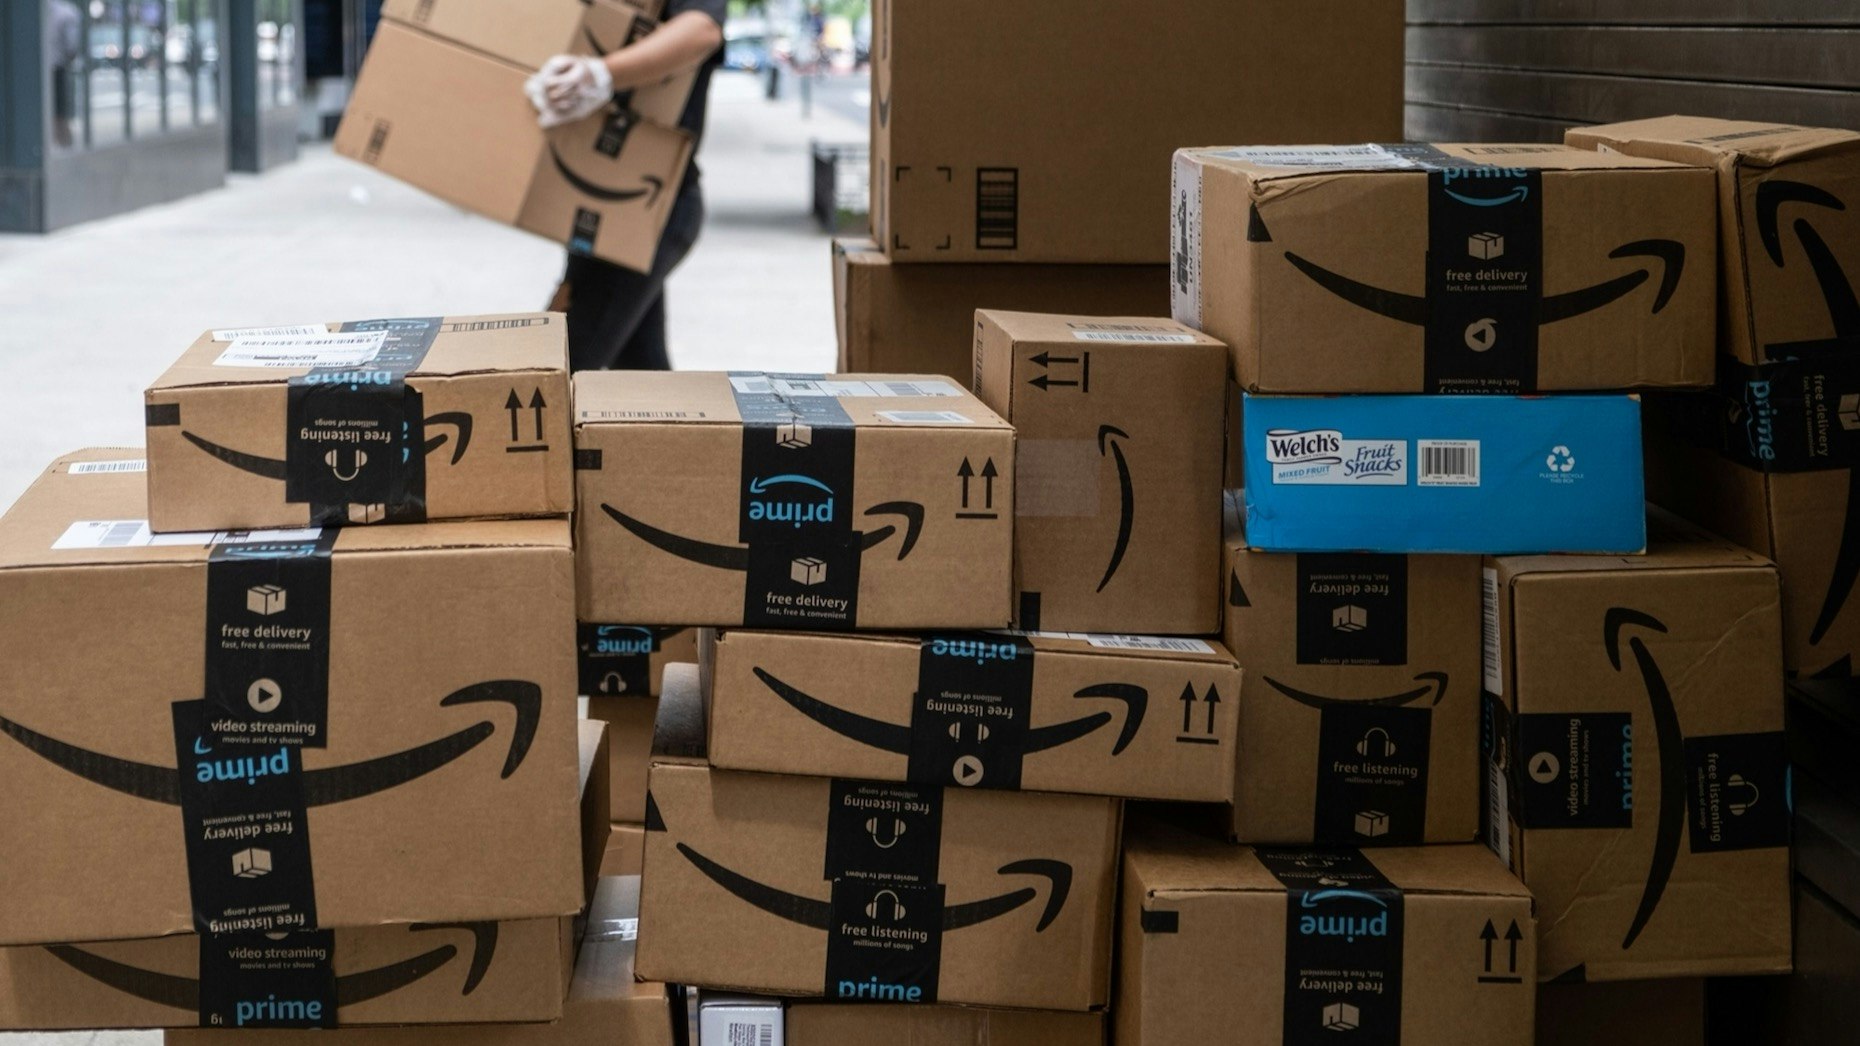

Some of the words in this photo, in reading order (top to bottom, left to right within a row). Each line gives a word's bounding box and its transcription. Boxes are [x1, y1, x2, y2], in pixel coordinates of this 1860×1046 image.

[1446, 269, 1474, 281] free
[1475, 268, 1528, 283] delivery
[1447, 284, 1462, 292] fast,
[304, 371, 391, 391] prime
[1814, 375, 1825, 400] free
[314, 418, 337, 427] songs
[338, 420, 346, 428] of
[348, 418, 378, 427] millions
[1748, 380, 1779, 460] prime
[300, 427, 360, 443] listening
[364, 430, 391, 443] free
[1816, 403, 1830, 457] delivery
[1270, 432, 1340, 458] Welch's
[1355, 443, 1396, 462] Fruit
[1278, 469, 1304, 479] MIXED
[1306, 465, 1331, 475] FRUIT
[1344, 458, 1402, 477] Snacks
[749, 497, 834, 528] prime
[1374, 573, 1389, 581] fast,
[1309, 582, 1361, 596] delivery
[1364, 584, 1390, 596] free
[766, 592, 792, 606] free
[796, 593, 848, 611] delivery
[766, 607, 780, 616] fast,
[783, 608, 798, 616] free
[807, 611, 847, 620] convenient
[221, 624, 249, 638] free
[253, 624, 311, 641] delivery
[221, 641, 240, 650] fast,
[240, 641, 257, 649] free
[266, 642, 311, 650] convenient
[597, 635, 653, 654] prime
[932, 639, 1017, 665] prime
[941, 691, 961, 699] songs
[963, 693, 971, 701] of
[972, 694, 1002, 703] millions
[926, 699, 984, 717] listening
[987, 706, 1013, 720] free
[211, 719, 247, 733] video
[249, 720, 316, 737] streaming
[222, 736, 250, 744] movies
[252, 736, 266, 744] and
[268, 736, 279, 744] tv
[280, 737, 304, 745] shows
[1567, 718, 1581, 781] streaming
[196, 746, 289, 786] prime
[1333, 760, 1359, 773] free
[1362, 762, 1418, 779] listening
[1707, 752, 1719, 779] free
[858, 787, 878, 796] songs
[881, 789, 888, 797] of
[890, 789, 918, 798] millions
[844, 795, 900, 812] listening
[1567, 782, 1579, 816] video
[274, 810, 292, 820] fast,
[904, 802, 930, 815] free
[1710, 782, 1723, 842] listening
[203, 815, 246, 826] convenient
[254, 812, 272, 821] free
[203, 824, 260, 840] delivery
[265, 822, 293, 835] free
[845, 870, 868, 879] shows
[868, 871, 877, 880] tv
[878, 872, 892, 881] and
[893, 872, 919, 881] movies
[223, 908, 246, 917] songs
[248, 907, 256, 915] of
[258, 903, 290, 912] millions
[210, 916, 273, 933] listening
[276, 913, 305, 926] free
[841, 923, 868, 937] free
[871, 925, 928, 943] listening
[1299, 910, 1387, 943] prime
[853, 939, 882, 948] millions
[884, 940, 892, 949] of
[893, 941, 914, 951] songs
[229, 947, 262, 959] video
[265, 946, 326, 961] streaming
[240, 961, 266, 969] movies
[267, 961, 281, 969] and
[283, 961, 291, 969] tv
[292, 961, 316, 969] shows
[1300, 969, 1341, 977] convenient
[1350, 970, 1365, 978] free
[1365, 970, 1384, 979] fast,
[838, 976, 923, 1003] prime
[1299, 977, 1353, 993] delivery
[1357, 981, 1384, 994] free
[236, 993, 323, 1026] prime
